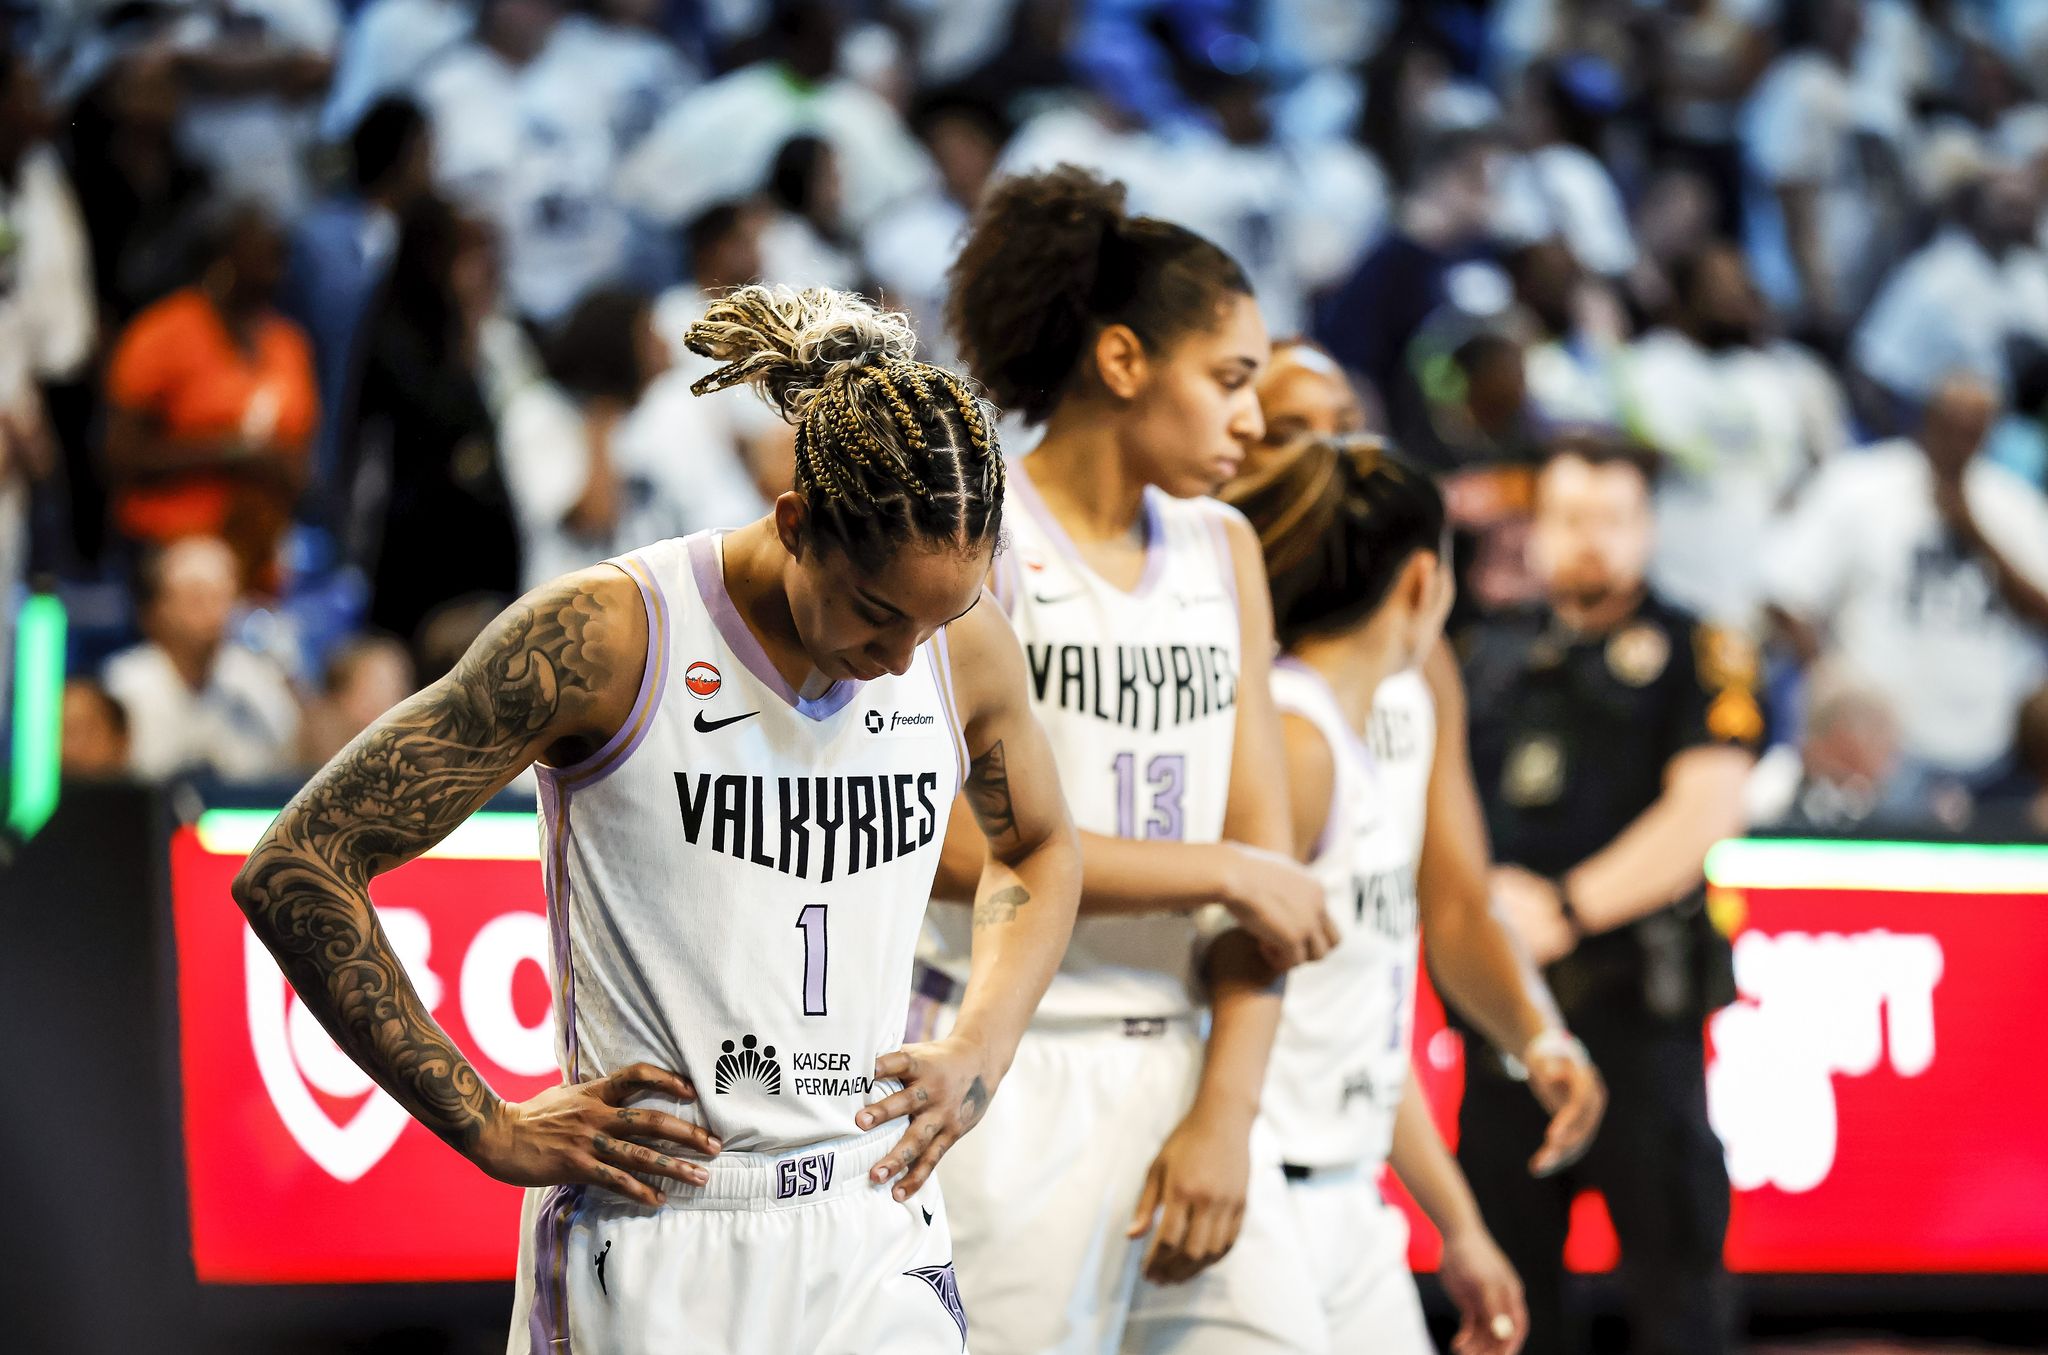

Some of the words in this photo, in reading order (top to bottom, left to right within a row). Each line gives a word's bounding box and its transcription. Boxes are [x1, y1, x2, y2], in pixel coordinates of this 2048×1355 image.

[890, 711, 935, 731] freedom
[673, 771, 937, 884] VALKYRIES
[1112, 752, 1185, 841] 13
[795, 904, 828, 1016] 1
[793, 1053, 852, 1071] KAISER
[776, 1151, 835, 1199] GSV
